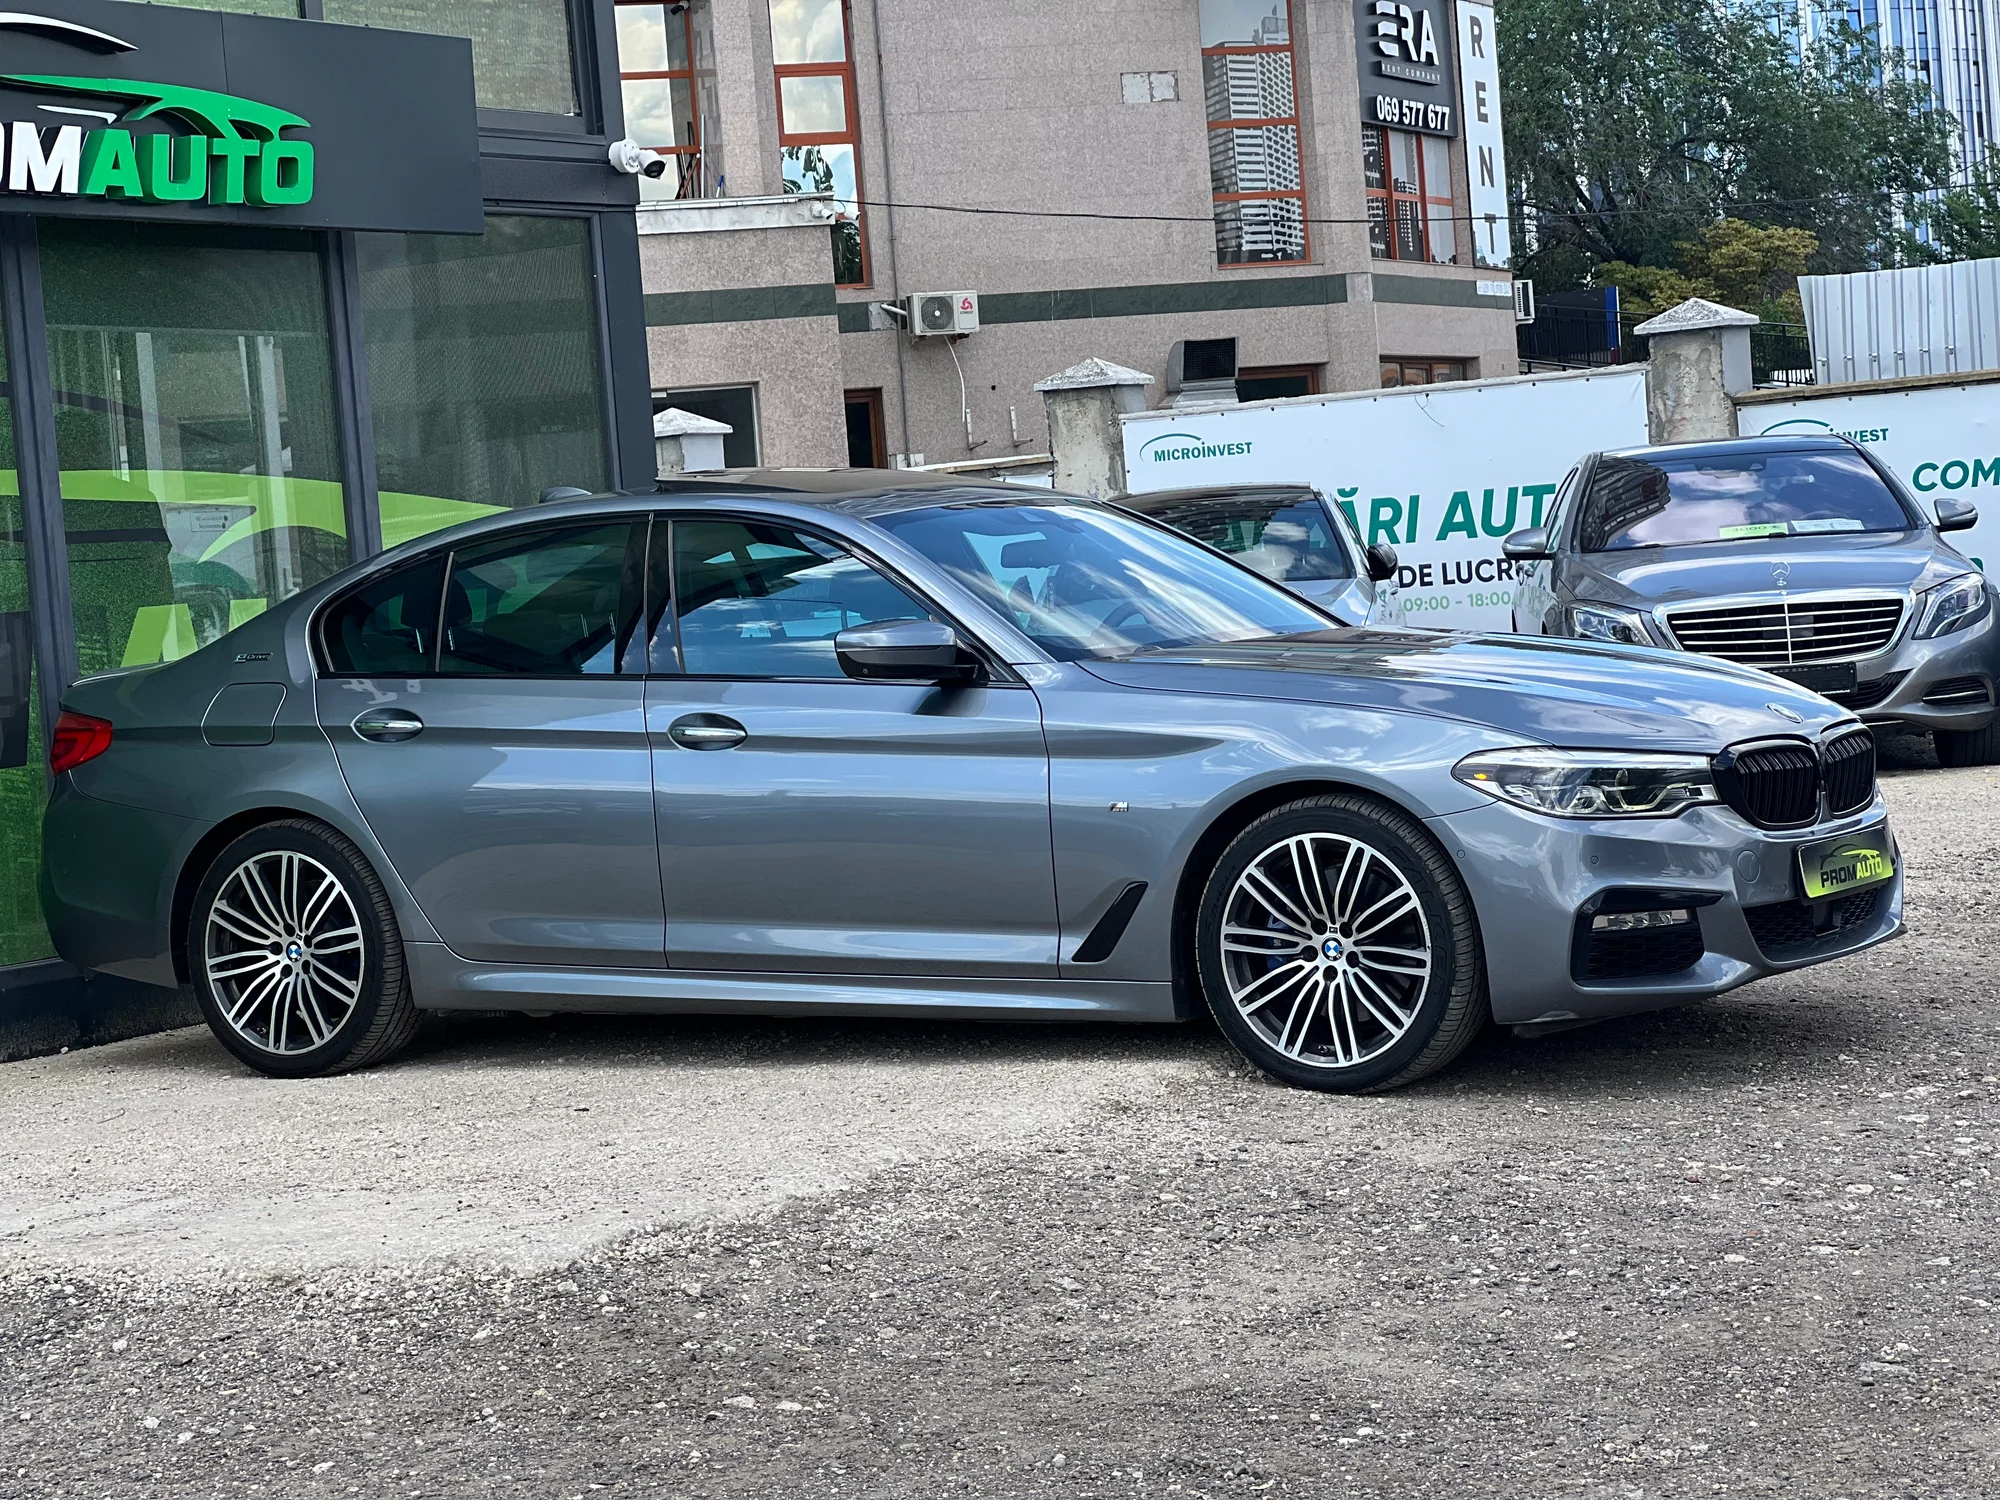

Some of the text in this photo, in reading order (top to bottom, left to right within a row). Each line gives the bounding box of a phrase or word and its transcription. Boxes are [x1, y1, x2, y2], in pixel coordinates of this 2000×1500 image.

[1376, 94, 1450, 131] 069 577 677
[0, 121, 314, 204] MAUTO
[1397, 563, 1434, 588] DE
[1403, 595, 1450, 613] 09:00
[1467, 590, 1512, 608] 18:00
[1820, 856, 1883, 889] PROMAUTO
